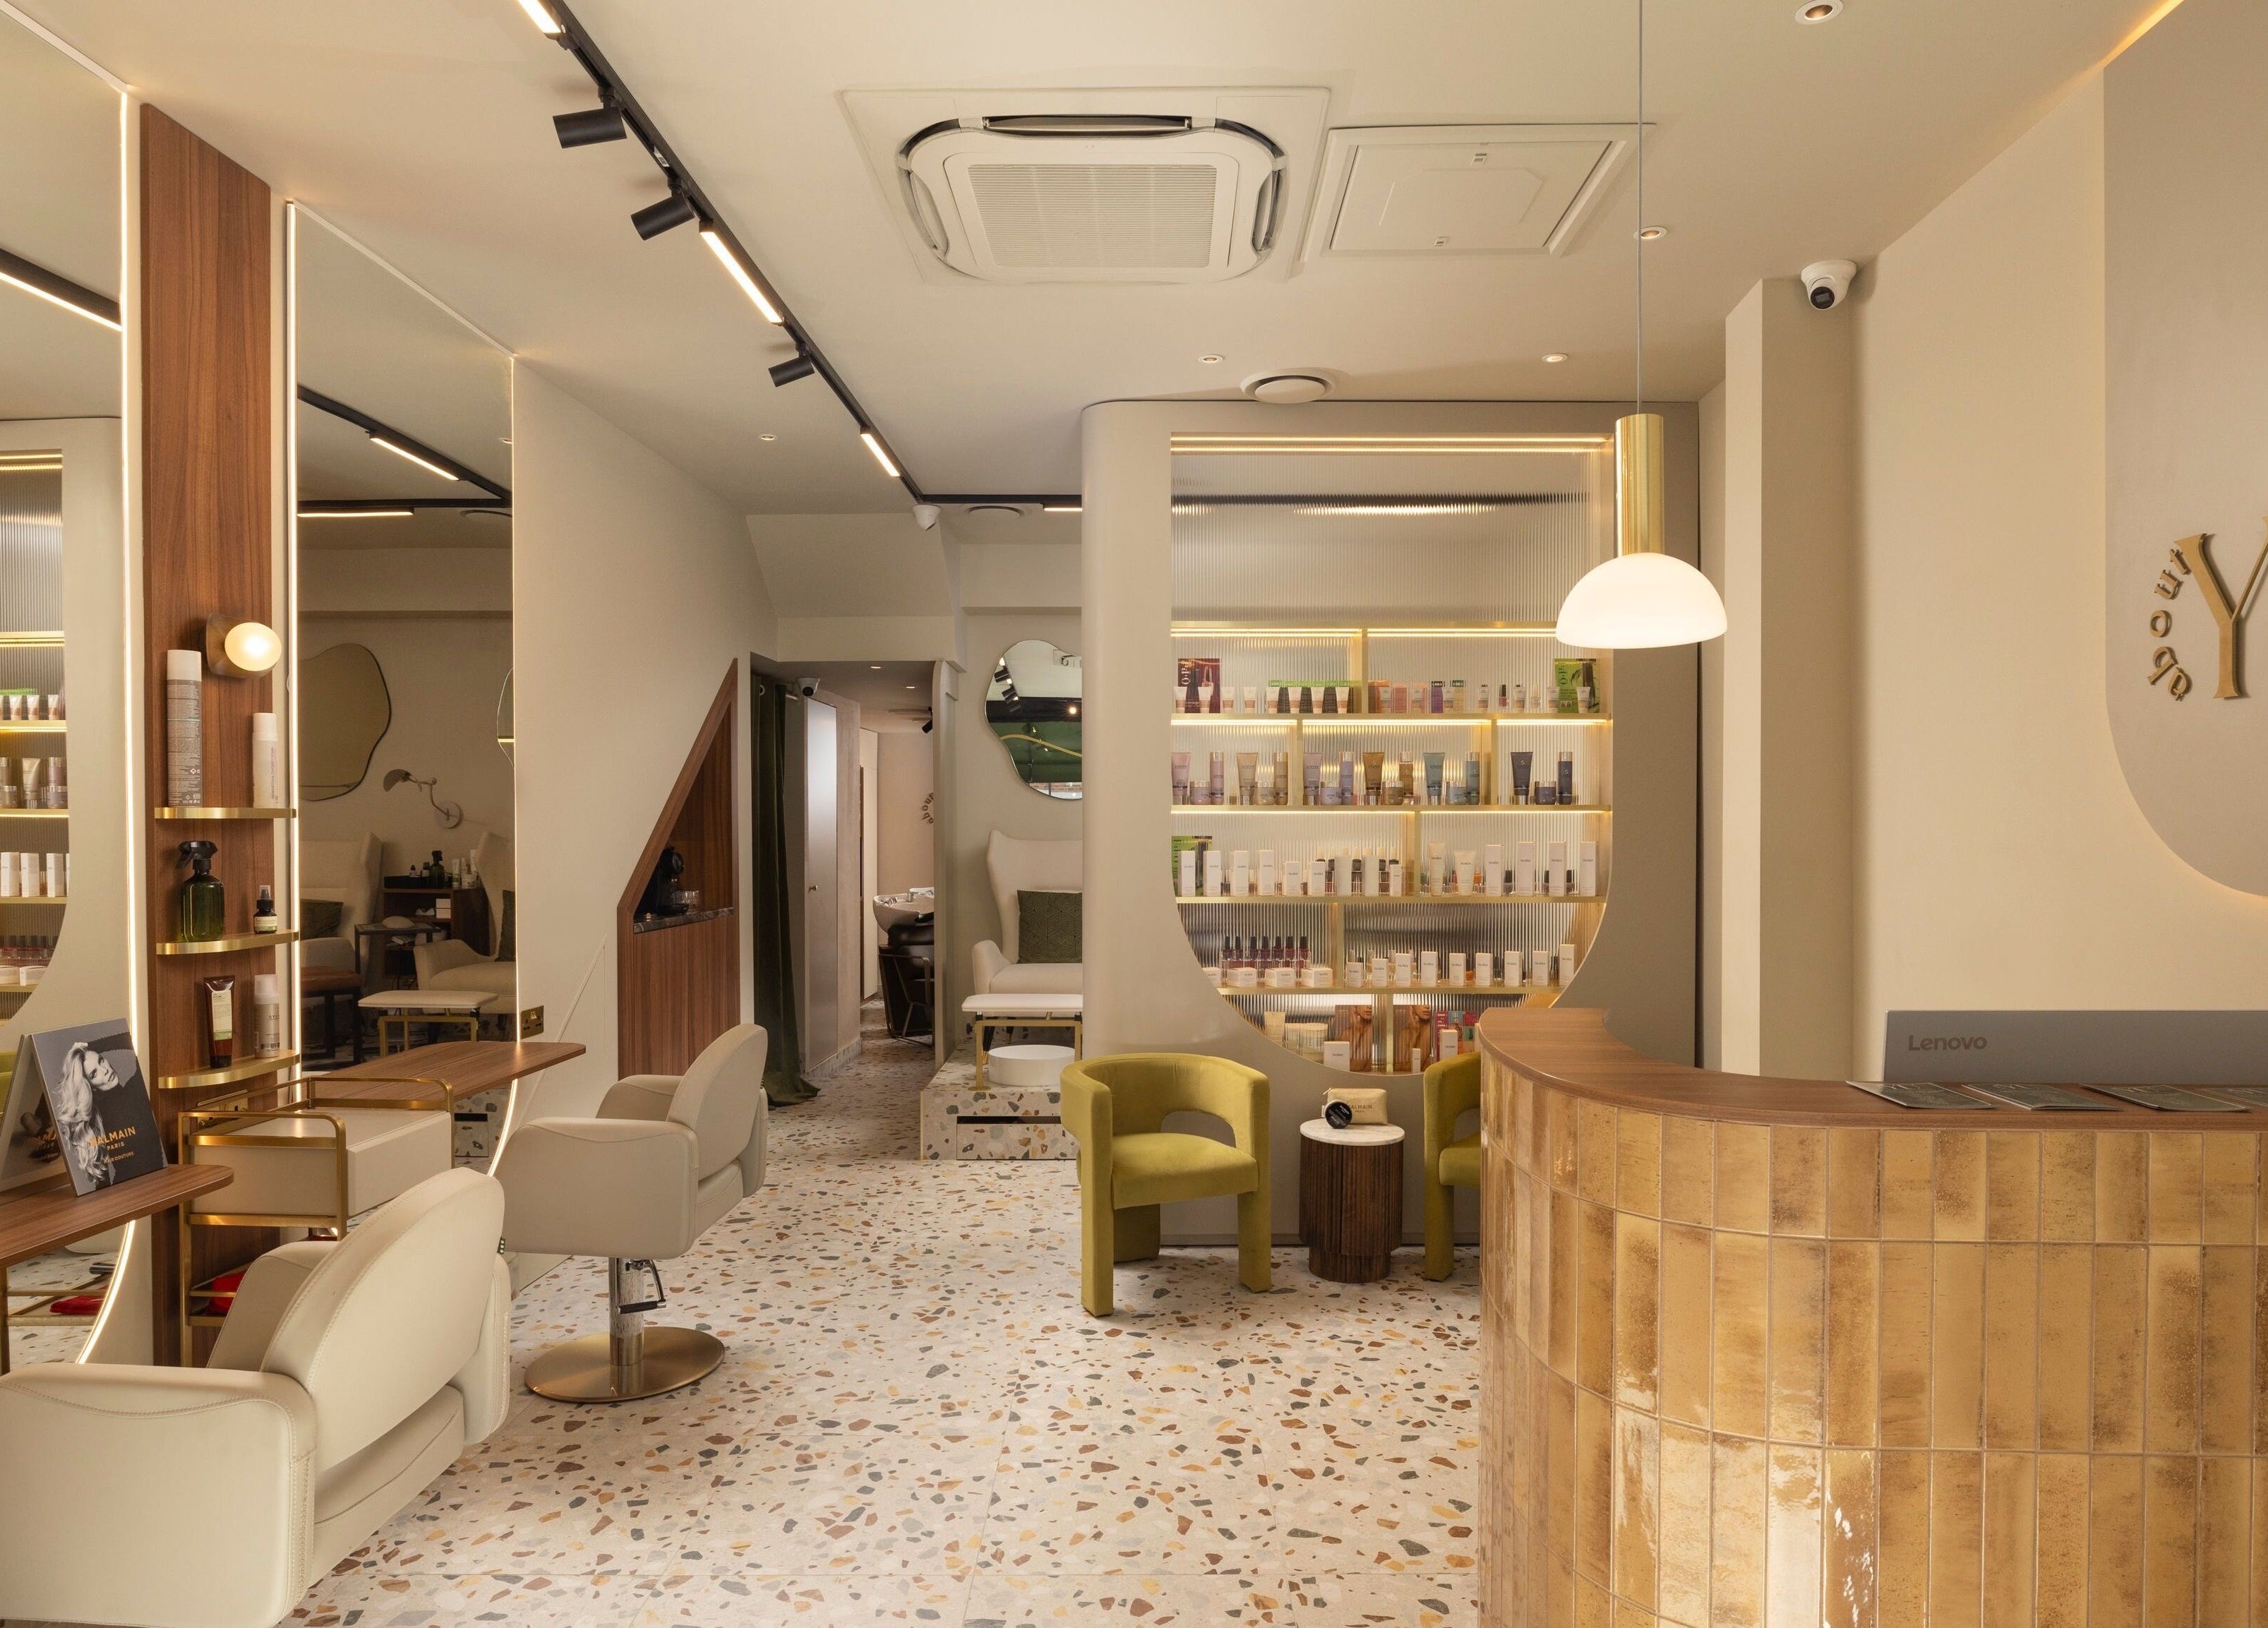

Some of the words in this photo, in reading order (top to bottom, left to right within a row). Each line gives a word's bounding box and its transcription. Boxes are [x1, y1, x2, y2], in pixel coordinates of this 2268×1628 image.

[1908, 1034, 1988, 1051] Lenovo
[88, 1126, 136, 1147] BALMAIN
[107, 1142, 125, 1151] PARIS
